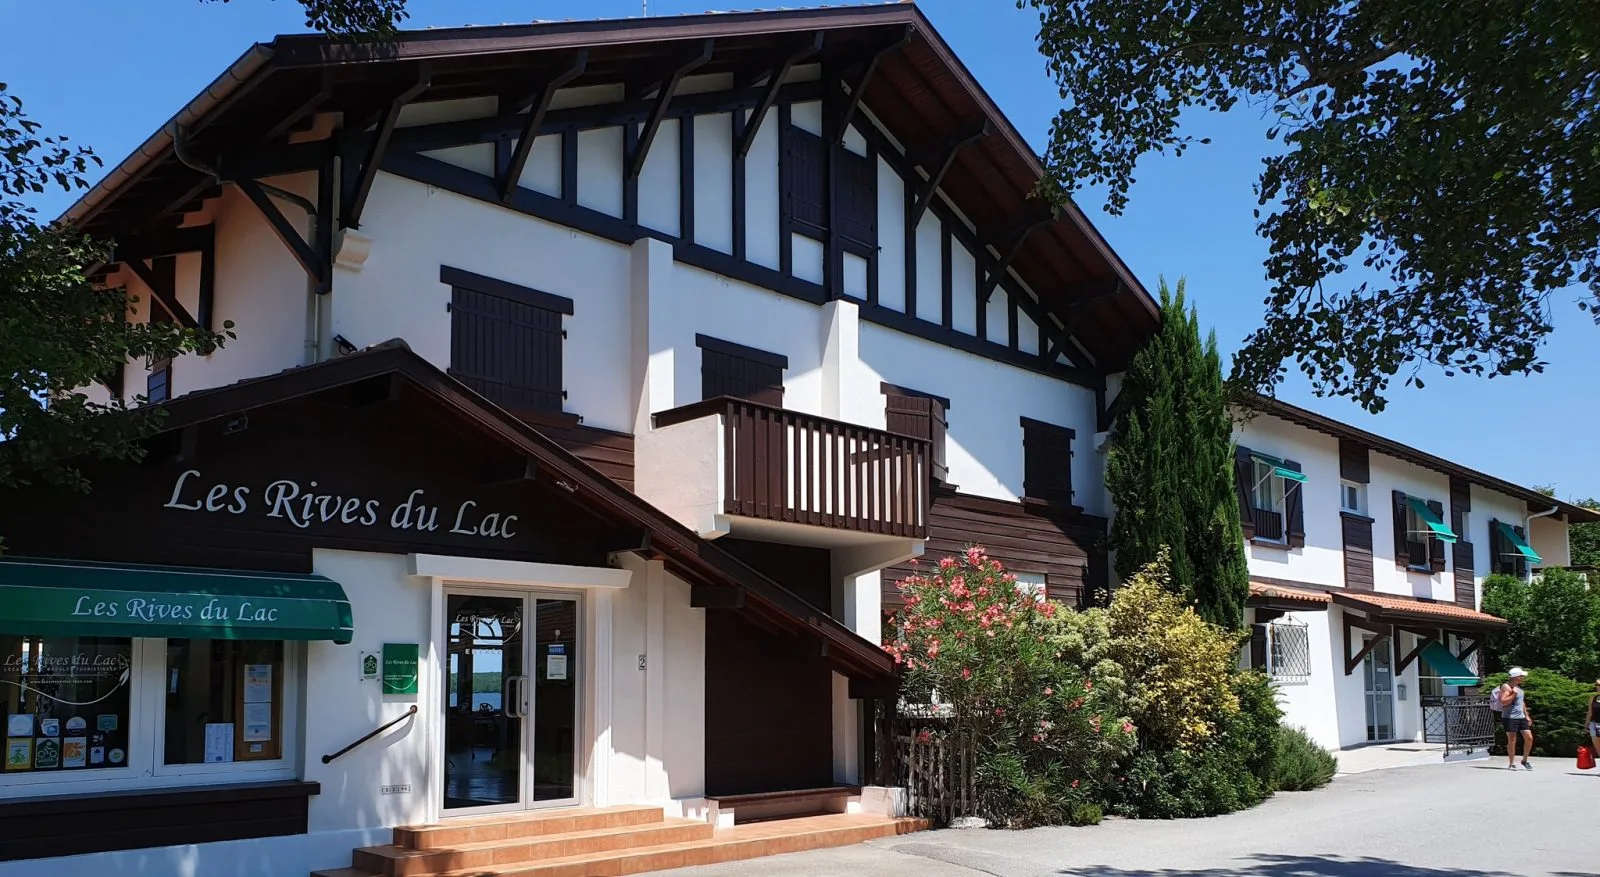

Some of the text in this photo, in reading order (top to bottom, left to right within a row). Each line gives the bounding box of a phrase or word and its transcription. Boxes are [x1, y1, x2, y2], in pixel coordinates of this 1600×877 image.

[163, 469, 519, 539] Les Rives du Lac
[71, 595, 278, 622] Les Rives du Lac
[93, 654, 117, 666] Lac
[639, 657, 646, 668] 2
